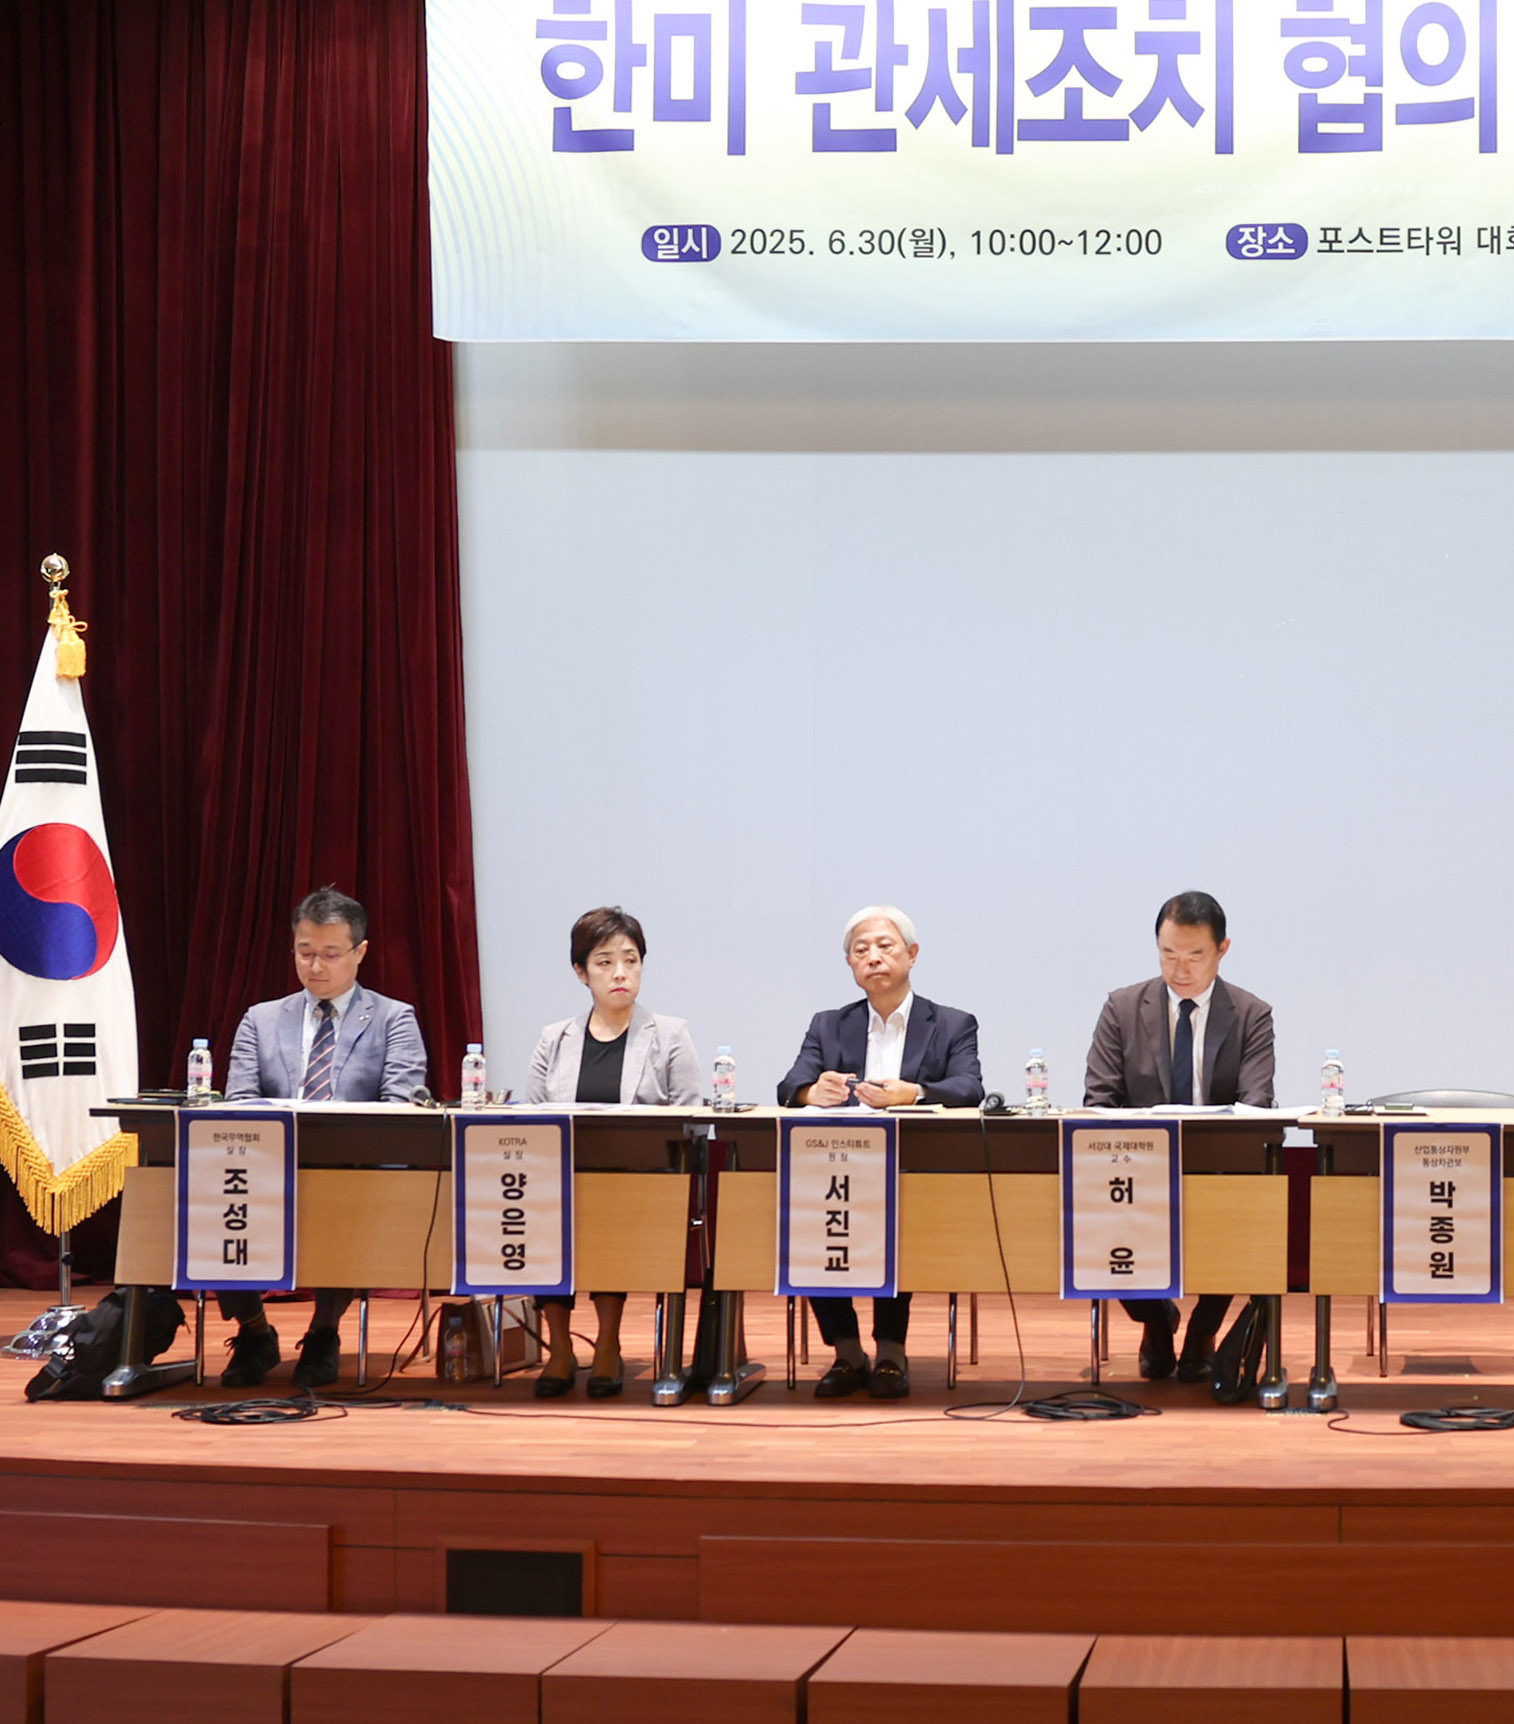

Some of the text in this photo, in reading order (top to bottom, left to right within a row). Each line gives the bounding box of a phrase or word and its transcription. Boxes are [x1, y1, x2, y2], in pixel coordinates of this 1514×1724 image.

[535, 0, 746, 156] 한미
[795, 0, 1234, 155] 관세조치
[1281, 0, 1498, 154] 협의
[652, 227, 1162, 260] 일시 2025. 6.30(월), 10:00~12:00
[1236, 227, 1298, 260] 장소
[1316, 225, 1461, 257] 포스트타워
[498, 1137, 528, 1147] KOTRA
[805, 1139, 829, 1149] GS&J
[1413, 1144, 1470, 1156] 산업통상자원부
[1422, 1157, 1463, 1169] 통상차관보
[221, 1167, 250, 1267] 조성대
[499, 1172, 528, 1272] 양은영
[824, 1173, 851, 1273] 서진교
[1428, 1179, 1457, 1280] 박종원
